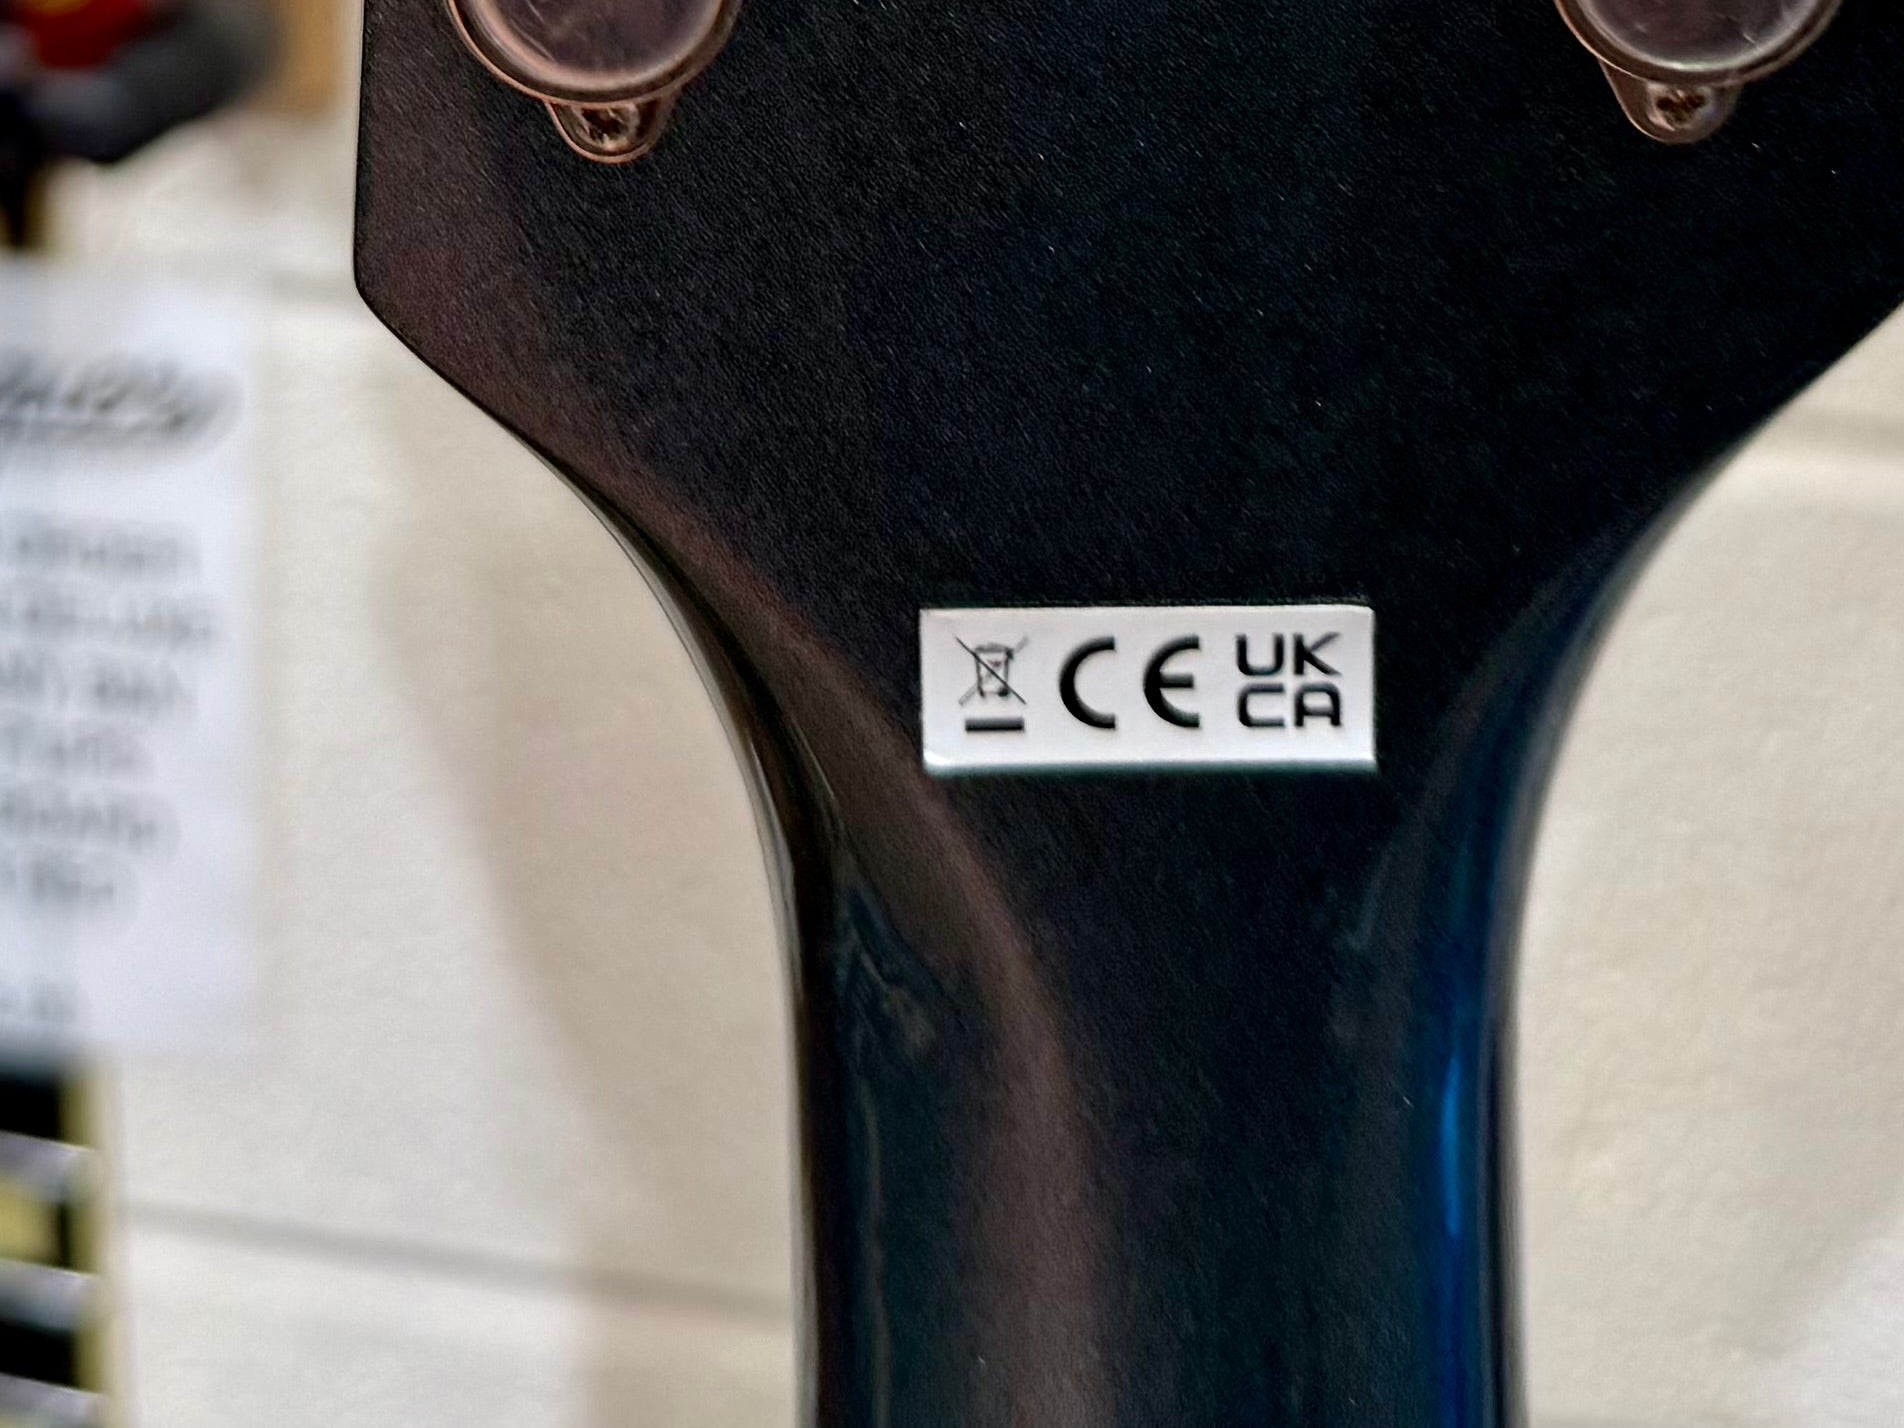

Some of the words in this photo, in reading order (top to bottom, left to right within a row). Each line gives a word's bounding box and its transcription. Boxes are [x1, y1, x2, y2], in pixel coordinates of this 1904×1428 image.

[1234, 631, 1343, 678] UK
[1059, 635, 1201, 731] CE
[1235, 681, 1343, 729] CA
